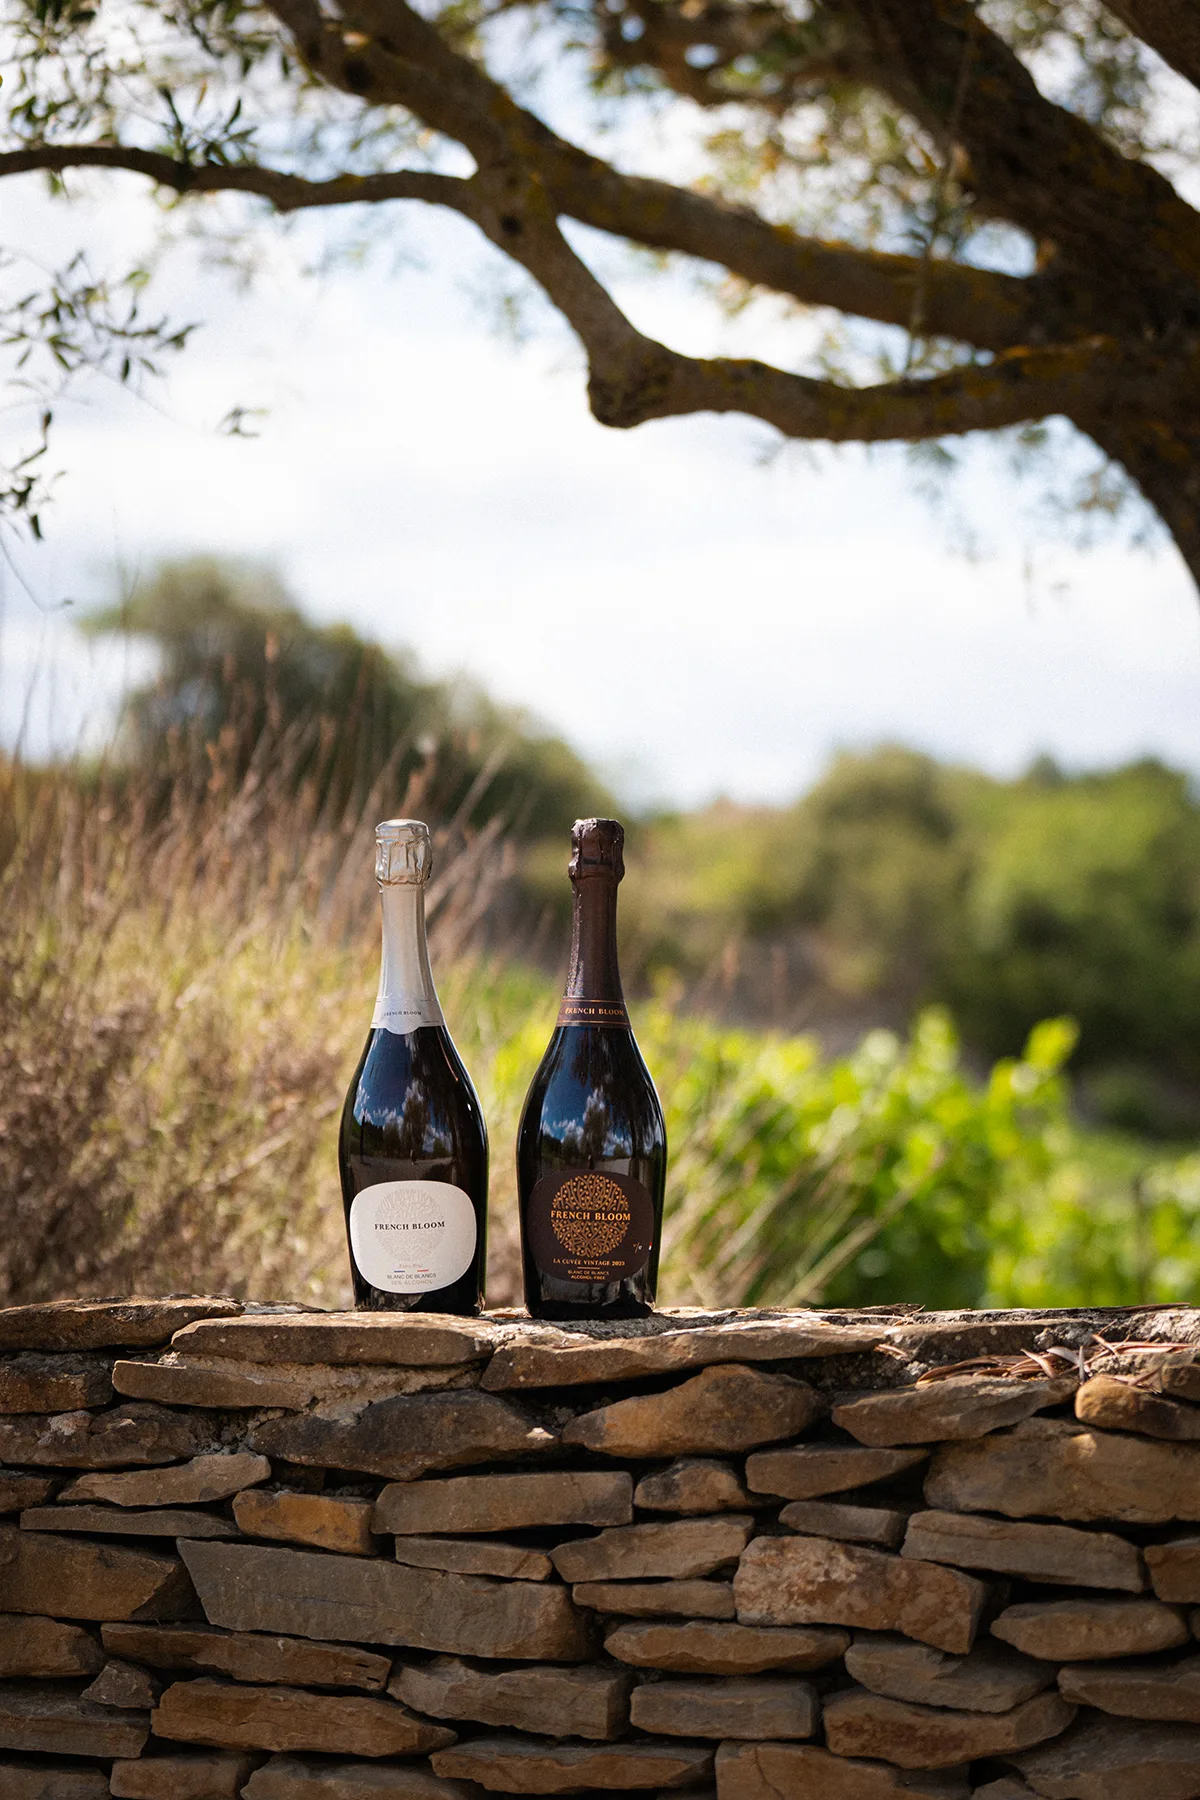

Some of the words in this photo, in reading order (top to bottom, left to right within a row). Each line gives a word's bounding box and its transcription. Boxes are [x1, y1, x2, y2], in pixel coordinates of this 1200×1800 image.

[551, 1210, 590, 1220] FRENCH
[595, 1213, 631, 1221] BLOOM
[412, 1221, 445, 1230] BLOOM
